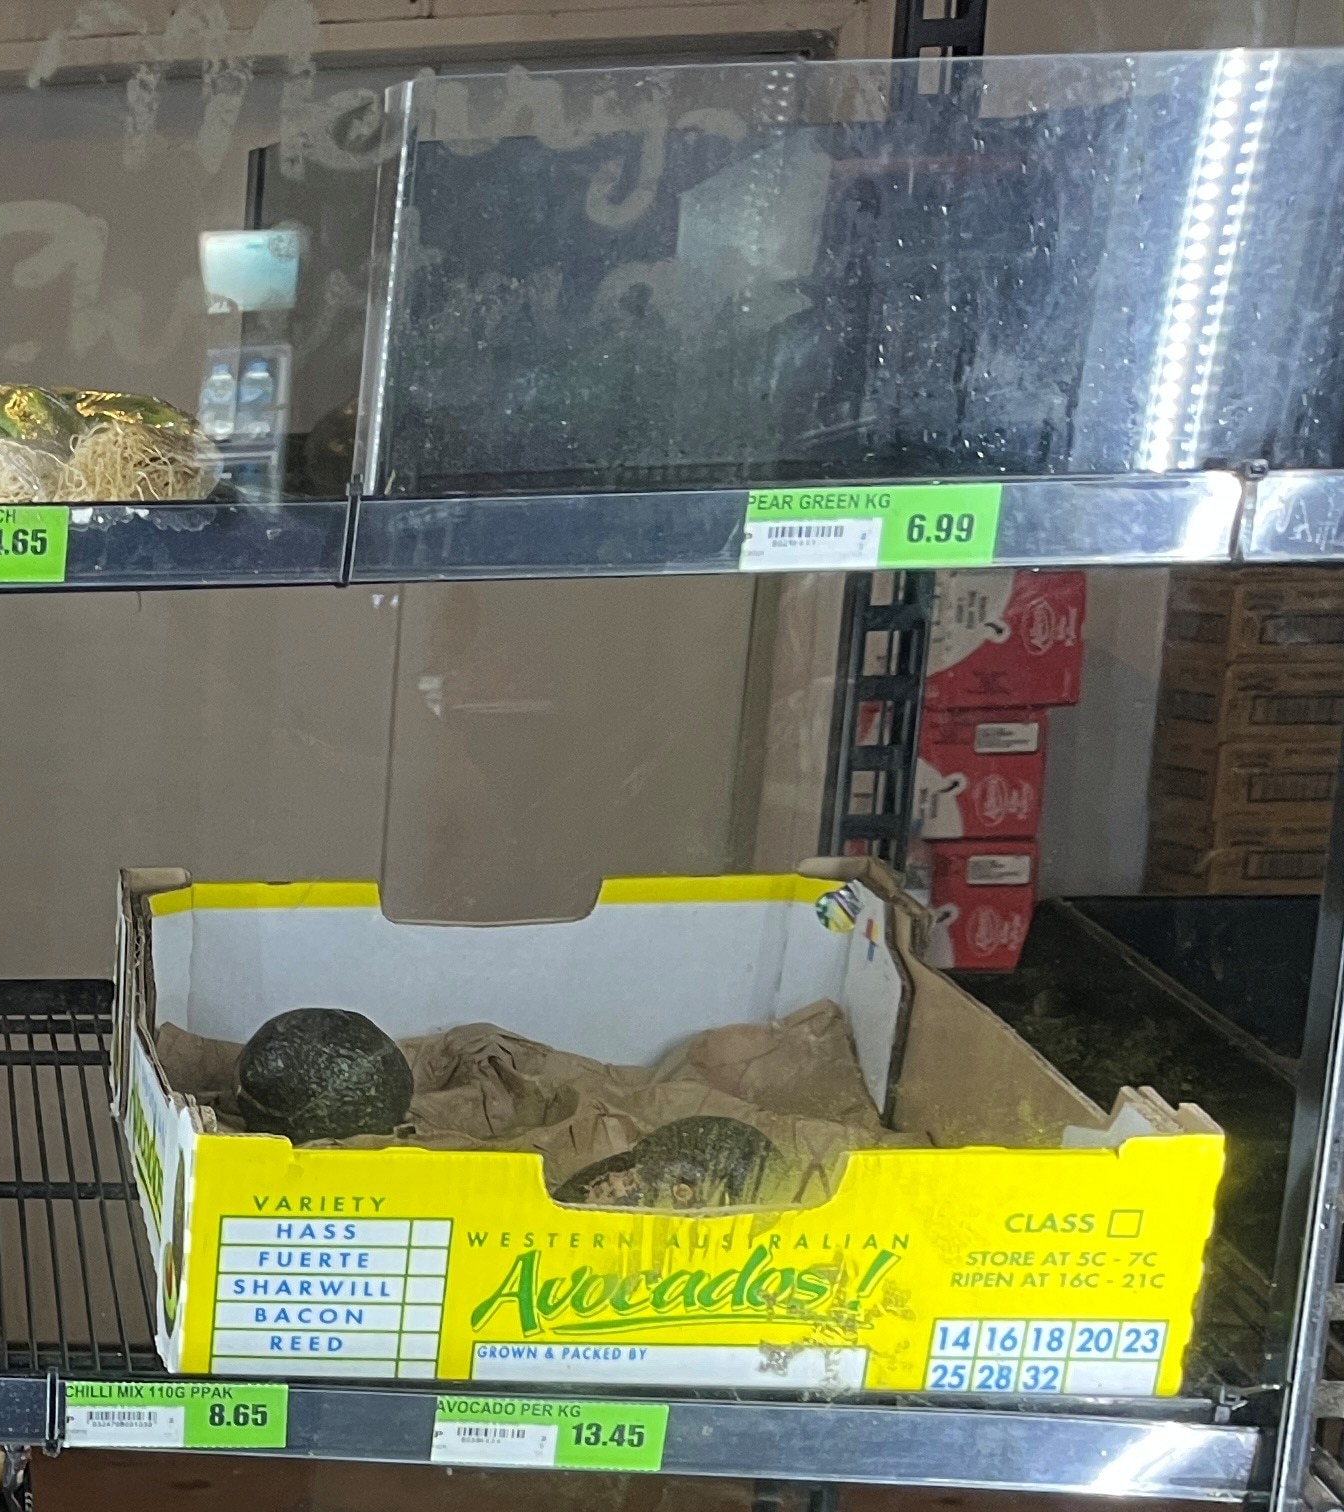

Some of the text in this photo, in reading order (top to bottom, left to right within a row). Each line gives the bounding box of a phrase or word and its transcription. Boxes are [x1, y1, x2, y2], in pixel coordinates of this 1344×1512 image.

[748, 493, 891, 510] PEAR GREEN KG
[907, 513, 975, 543] 6.99
[253, 1195, 386, 1213] VARIETY
[276, 1223, 357, 1240] HASS
[1004, 1213, 1096, 1233] CLASS
[467, 1231, 634, 1249] WESTERN
[258, 1251, 370, 1269] FUERTE
[965, 1251, 1036, 1267] STORE
[1040, 1251, 1072, 1266] AT
[1076, 1251, 1107, 1267] 5C
[1128, 1251, 1158, 1267] 7C
[233, 1279, 391, 1297] SHARWILL
[950, 1272, 1014, 1288] RIPEN
[1019, 1273, 1049, 1288] AT
[1059, 1273, 1100, 1289] 16C
[1121, 1273, 1166, 1289] 21C
[255, 1307, 364, 1325] BACON
[269, 1335, 344, 1351] REED
[939, 1326, 1160, 1353] 14 16 18 20 23
[477, 1345, 648, 1361] GROWN & PACKED BY
[931, 1364, 1059, 1390] 25 28 32
[65, 1385, 233, 1400] CHILLI MIX 110G PPAK
[208, 1403, 268, 1427] 8.65
[436, 1400, 582, 1418] AVOCADO PER KG
[571, 1422, 645, 1448] 13.45
